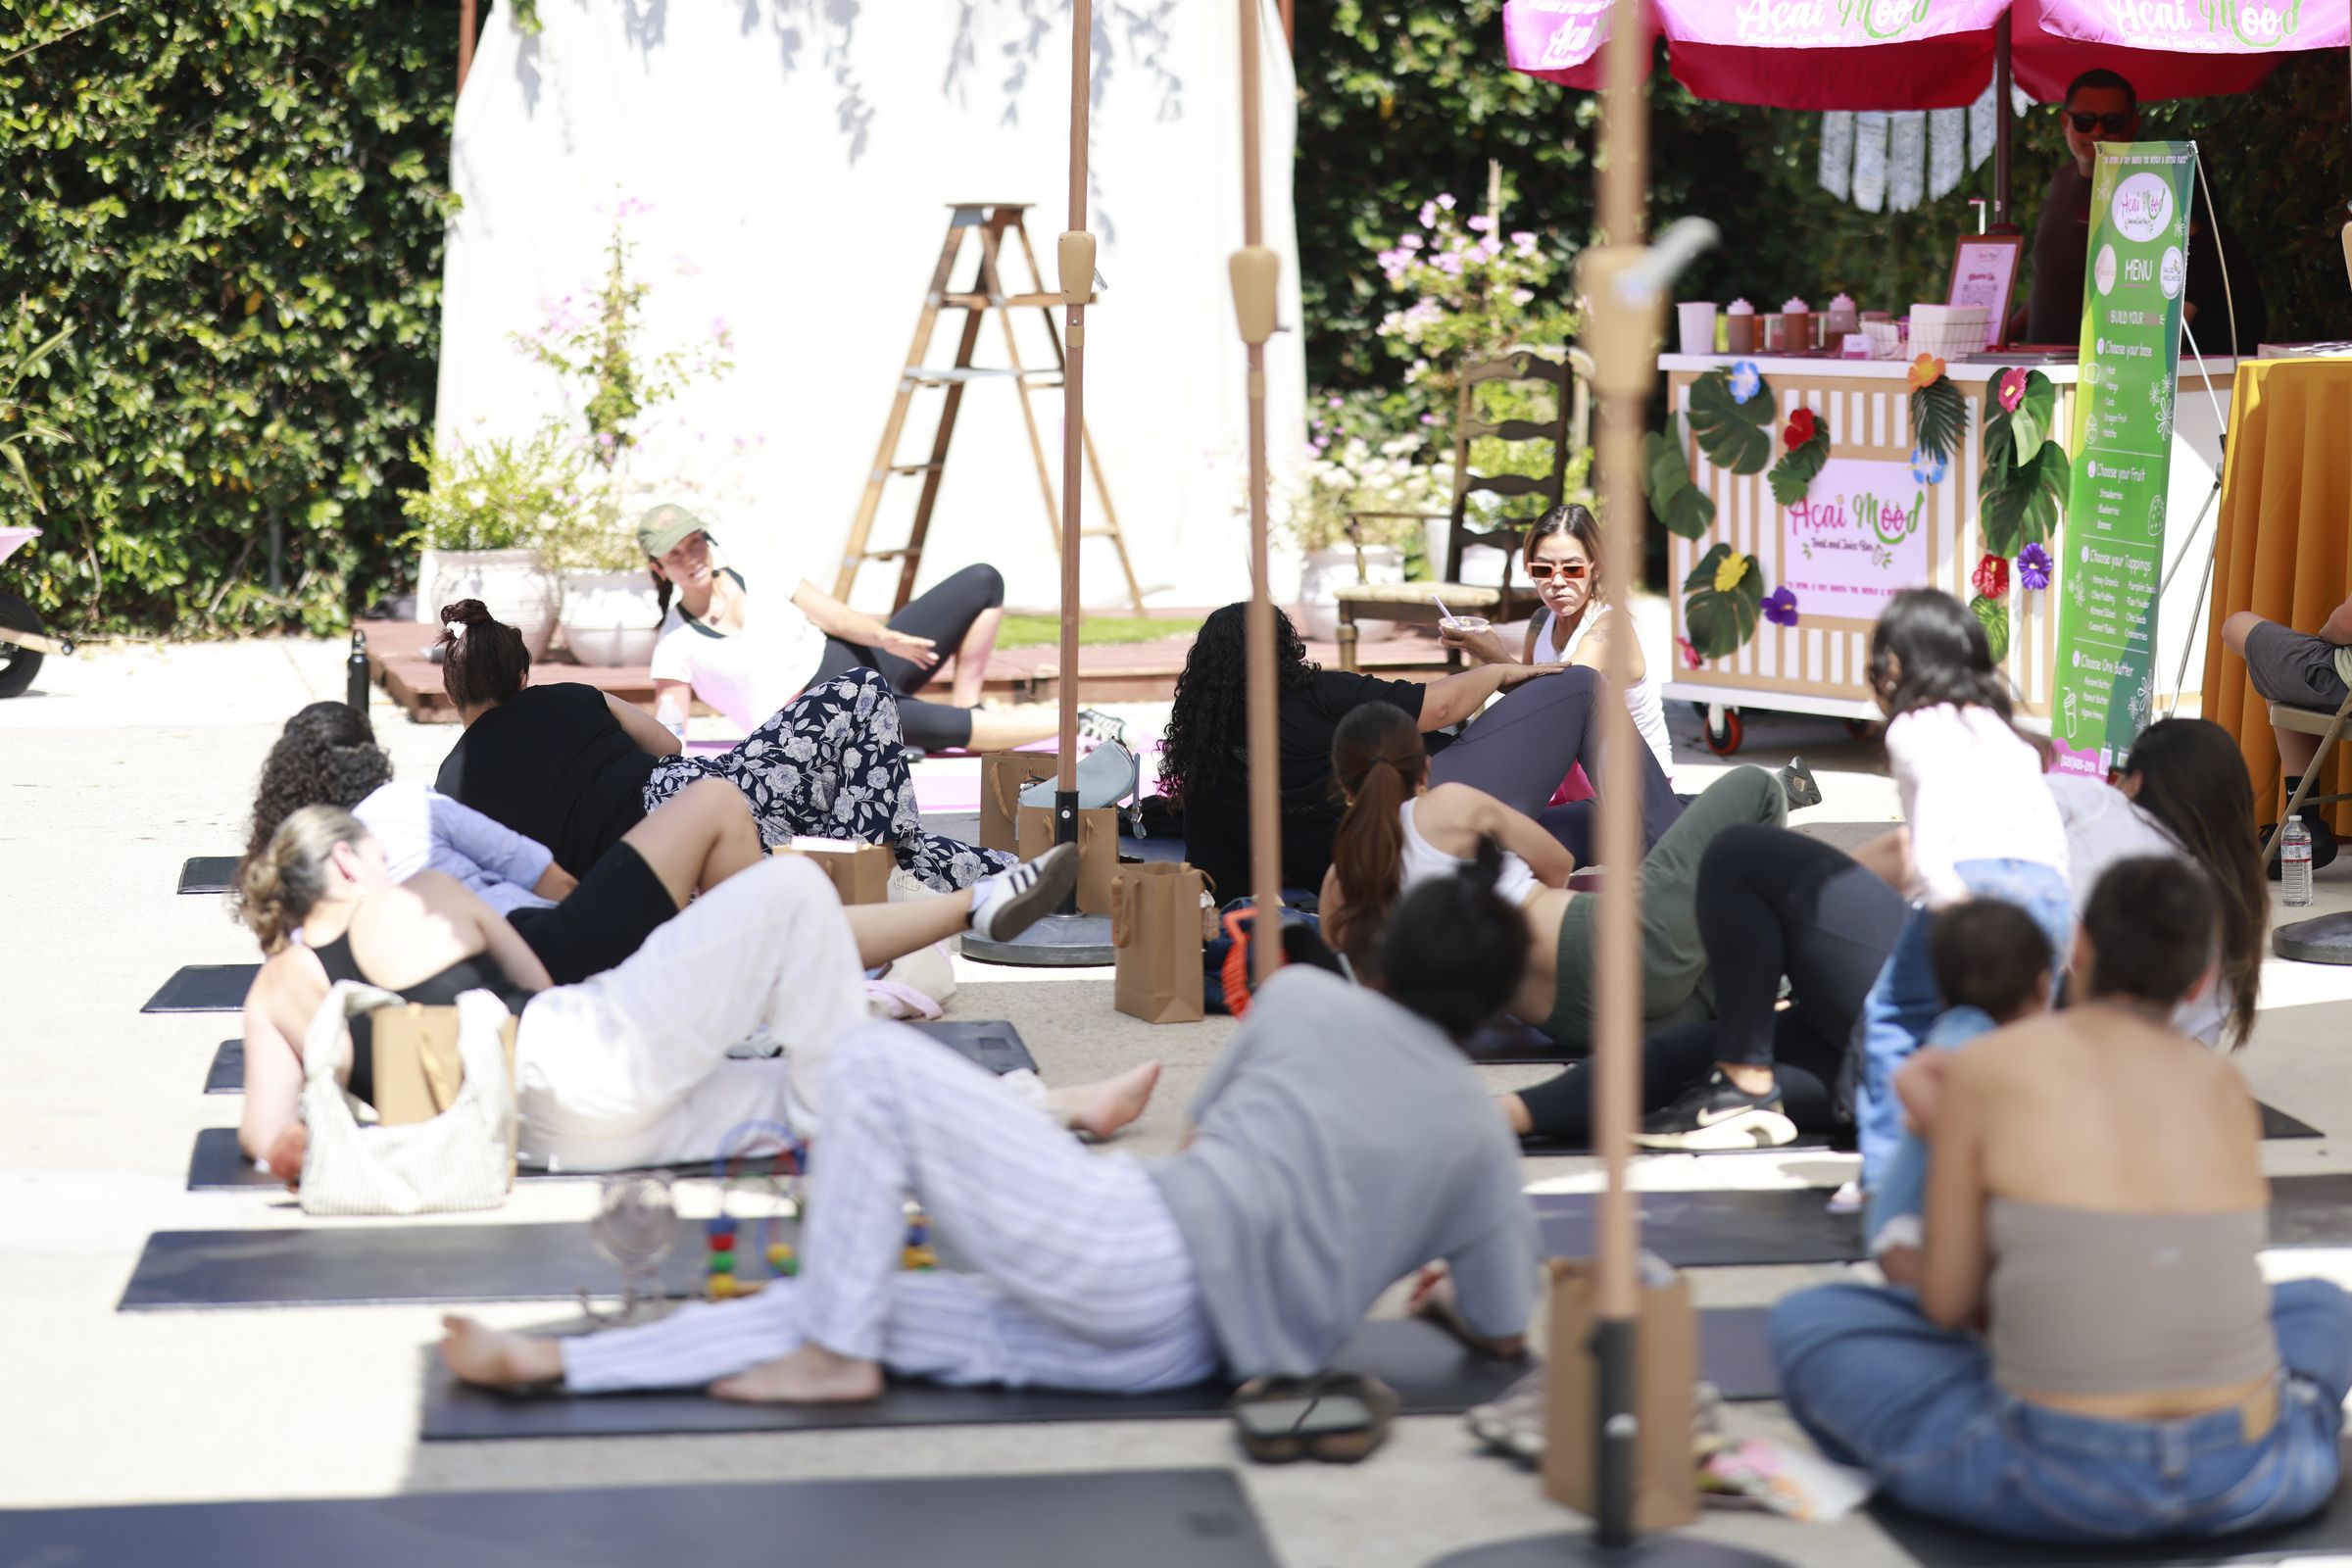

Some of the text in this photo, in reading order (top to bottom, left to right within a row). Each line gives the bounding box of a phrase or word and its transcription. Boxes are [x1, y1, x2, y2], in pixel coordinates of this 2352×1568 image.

[2125, 259, 2153, 281] MENU
[2110, 310, 2128, 324] BUILD
[2129, 311, 2144, 325] YOUR
[2105, 340, 2125, 355] Choose
[2126, 345, 2138, 361] your
[2139, 342, 2152, 358] base
[2097, 463, 2117, 478] Choose
[2118, 469, 2131, 485] your
[2131, 466, 2145, 482] Fruit
[1852, 490, 1925, 545] Mood
[2090, 549, 2110, 564] Choose
[2111, 557, 2124, 571] your
[2125, 555, 2152, 577] Toppings
[2081, 654, 2101, 671] Choose
[2102, 659, 2113, 673] One
